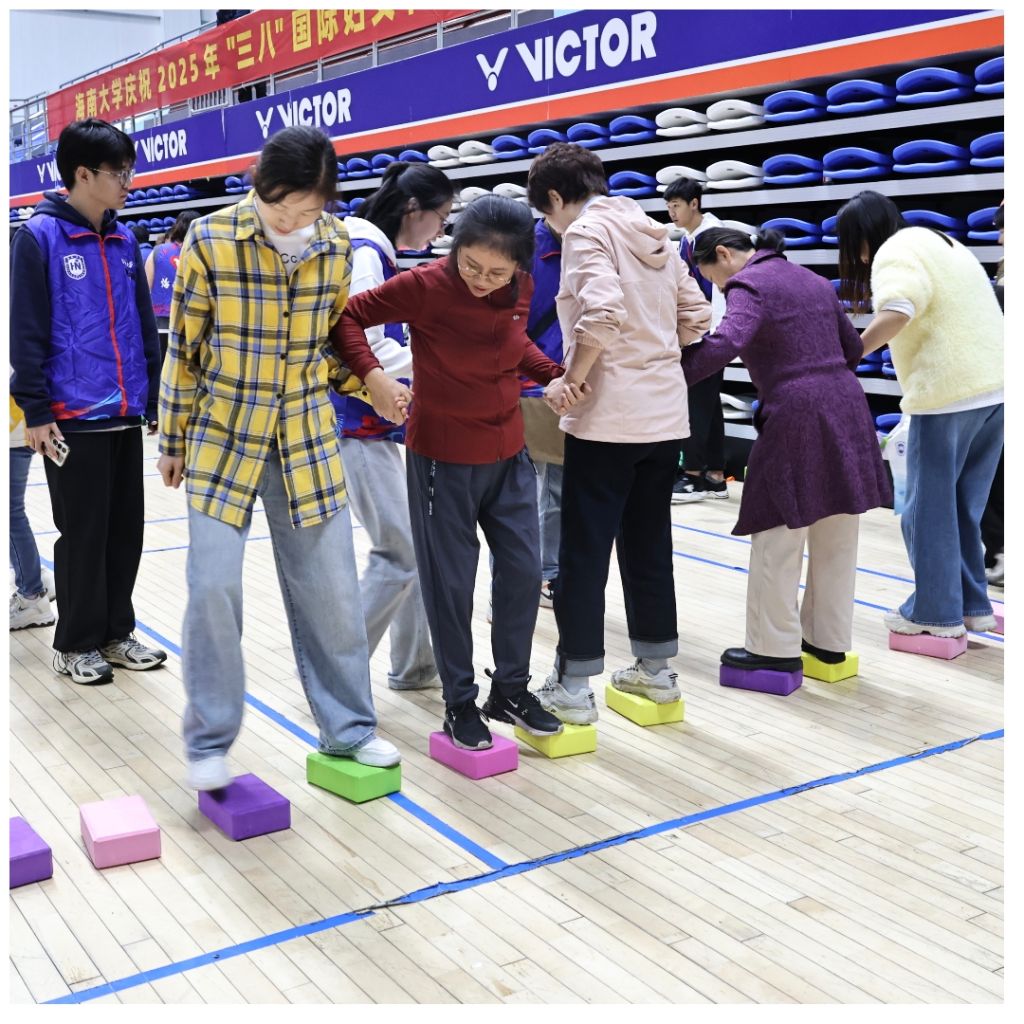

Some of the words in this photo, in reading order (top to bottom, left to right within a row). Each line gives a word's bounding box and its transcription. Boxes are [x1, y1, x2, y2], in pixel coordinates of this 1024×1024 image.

[514, 10, 658, 83] VICTOR
[158, 53, 199, 93] 2025
[276, 87, 352, 129] VICTOR
[141, 128, 187, 164] VICTOR
